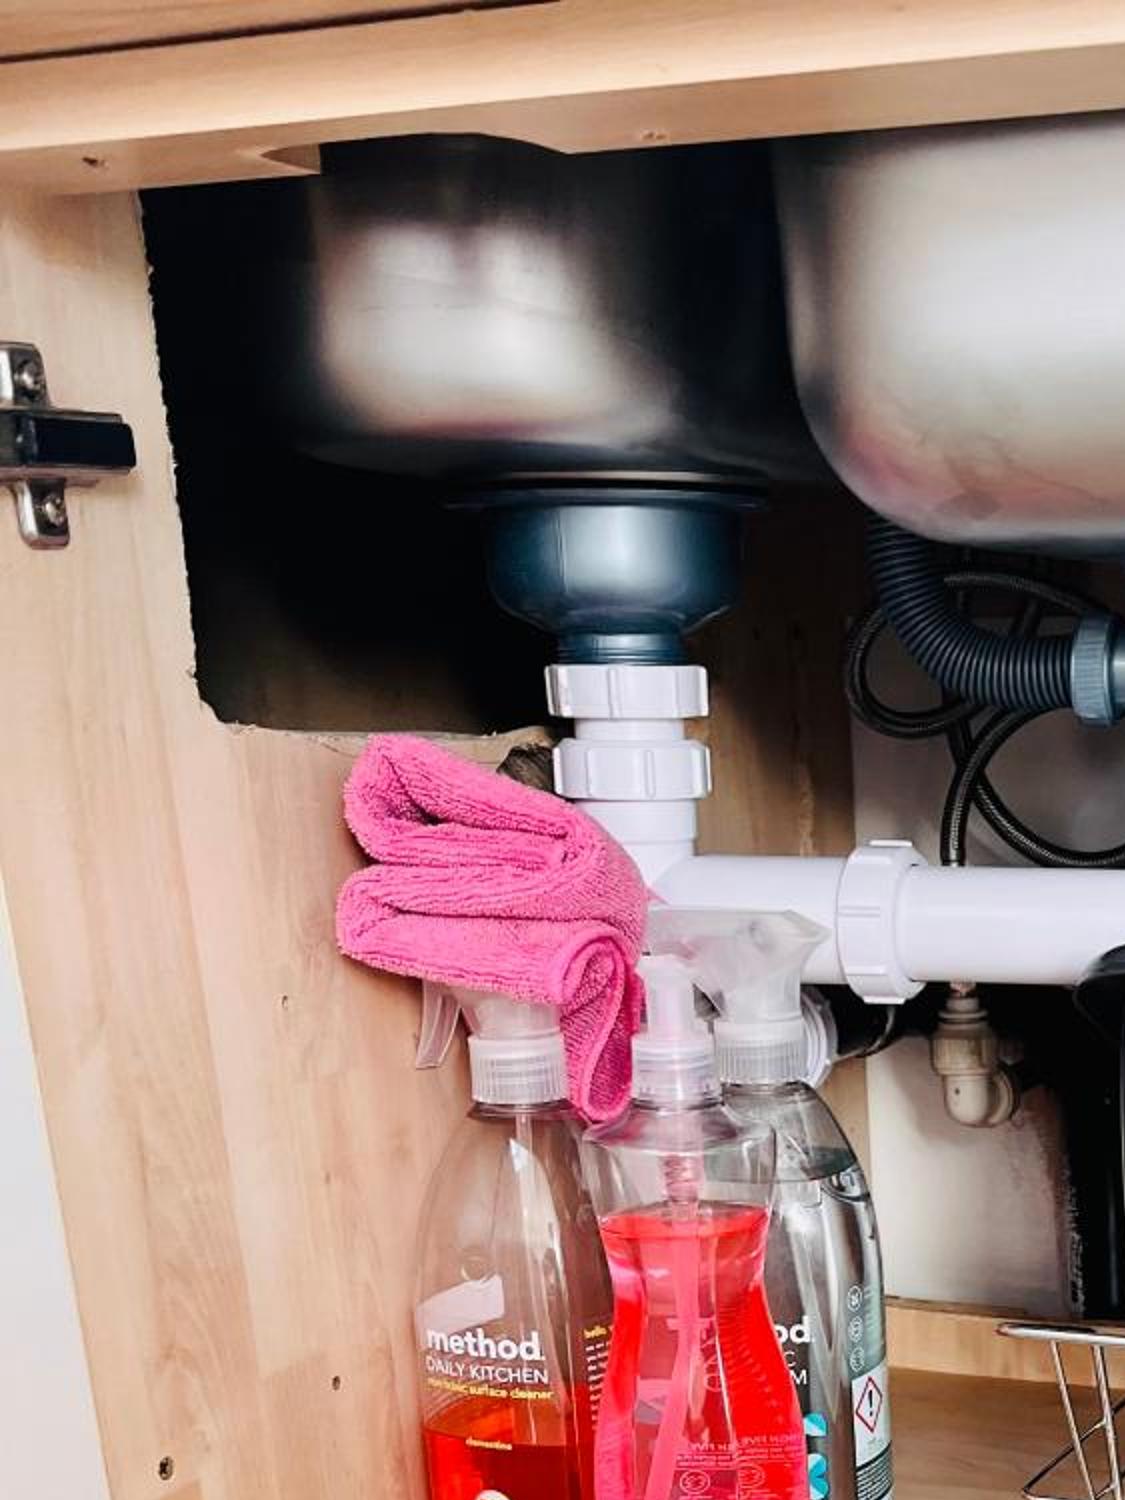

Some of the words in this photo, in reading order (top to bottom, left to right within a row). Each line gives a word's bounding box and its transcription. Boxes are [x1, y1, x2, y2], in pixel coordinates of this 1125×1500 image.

[426, 1327, 546, 1361] method.
[426, 1355, 464, 1378] DAILY
[470, 1363, 549, 1385] KITCHEN
